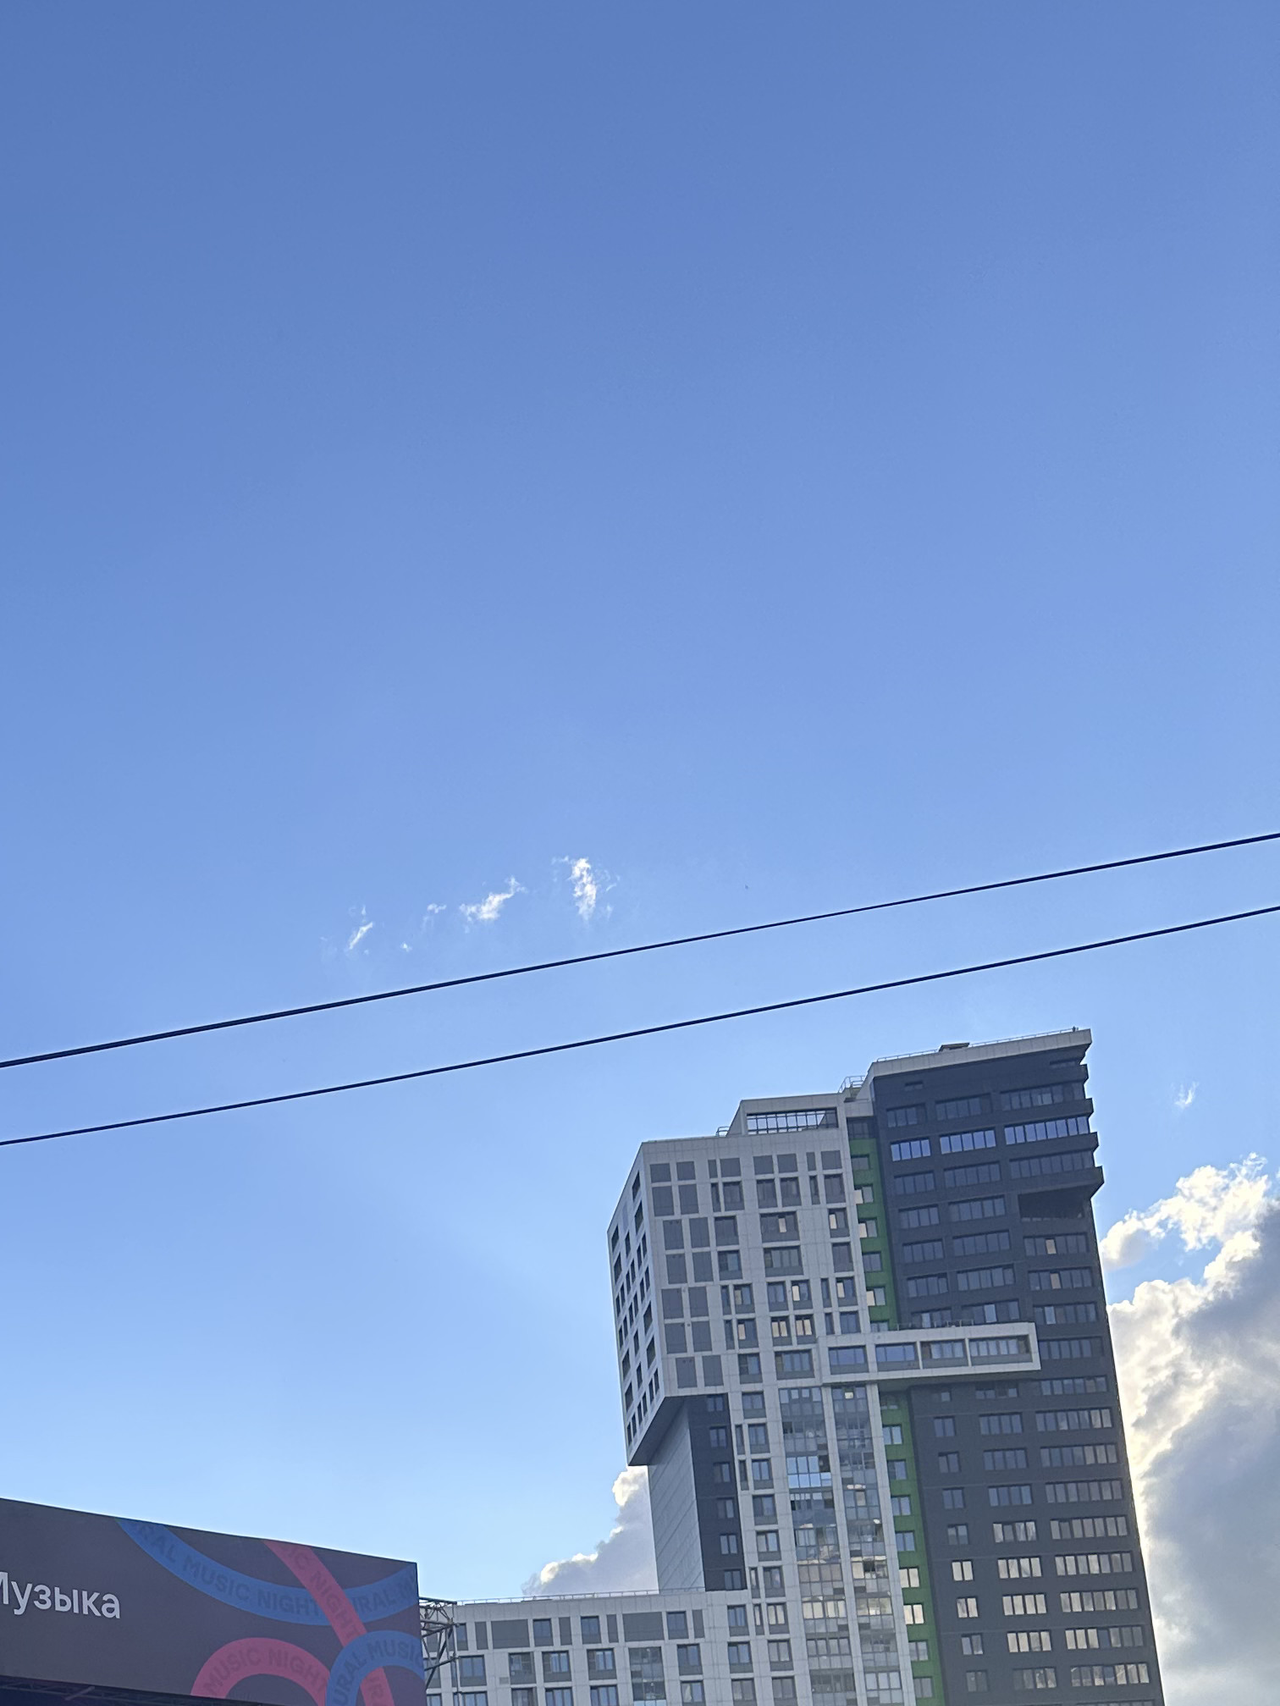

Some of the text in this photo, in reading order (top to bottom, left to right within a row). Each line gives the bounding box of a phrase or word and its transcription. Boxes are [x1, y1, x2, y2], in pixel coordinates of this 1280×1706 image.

[132, 1522, 177, 1564] RAL
[183, 1558, 251, 1602] MUSIC
[204, 1648, 262, 1695] MUSIC
[332, 1651, 368, 1706] URAL
